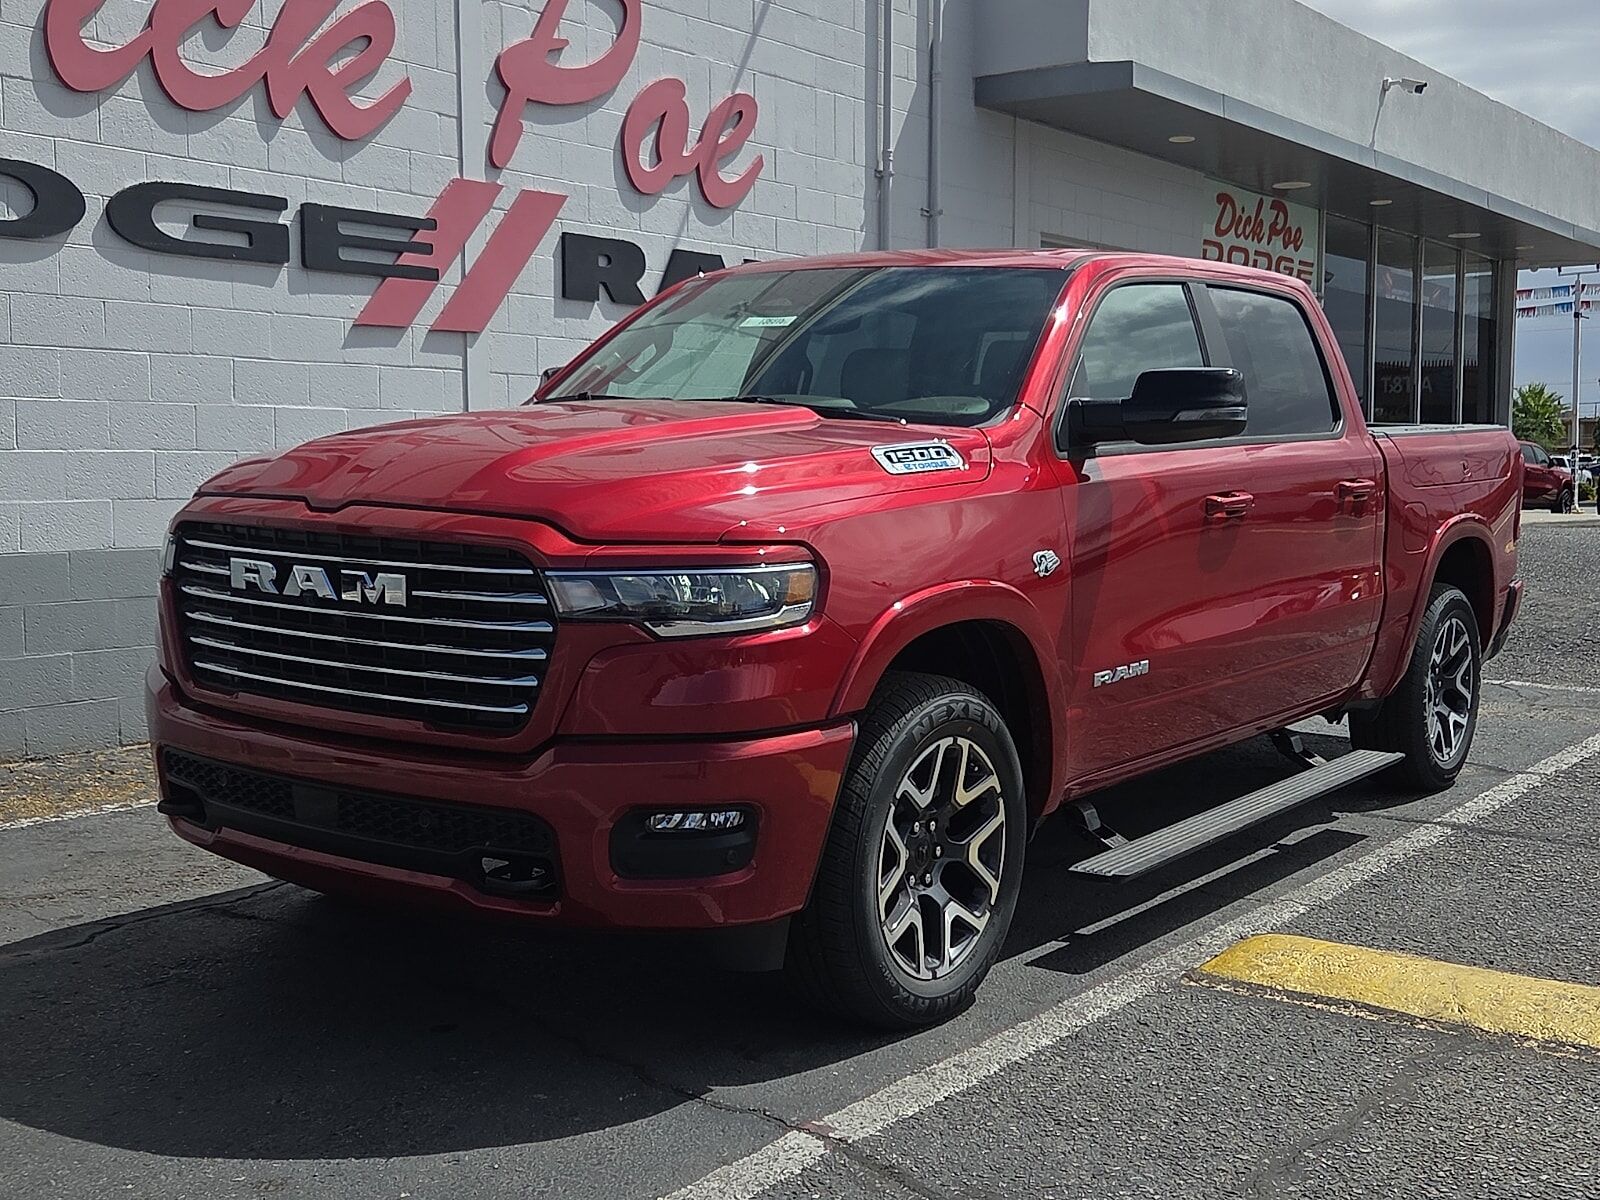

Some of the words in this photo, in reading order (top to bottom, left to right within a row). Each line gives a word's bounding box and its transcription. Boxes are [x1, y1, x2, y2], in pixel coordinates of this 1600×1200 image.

[489, 0, 764, 209] Poe
[1215, 192, 1265, 244] Dick
[1266, 199, 1304, 252] Poe
[562, 232, 761, 306] RA
[1202, 239, 1314, 286] DODGE
[884, 446, 948, 464] 1500
[229, 556, 407, 608] RAM
[1093, 660, 1150, 688] RAM
[911, 701, 1000, 743] NEXEN
